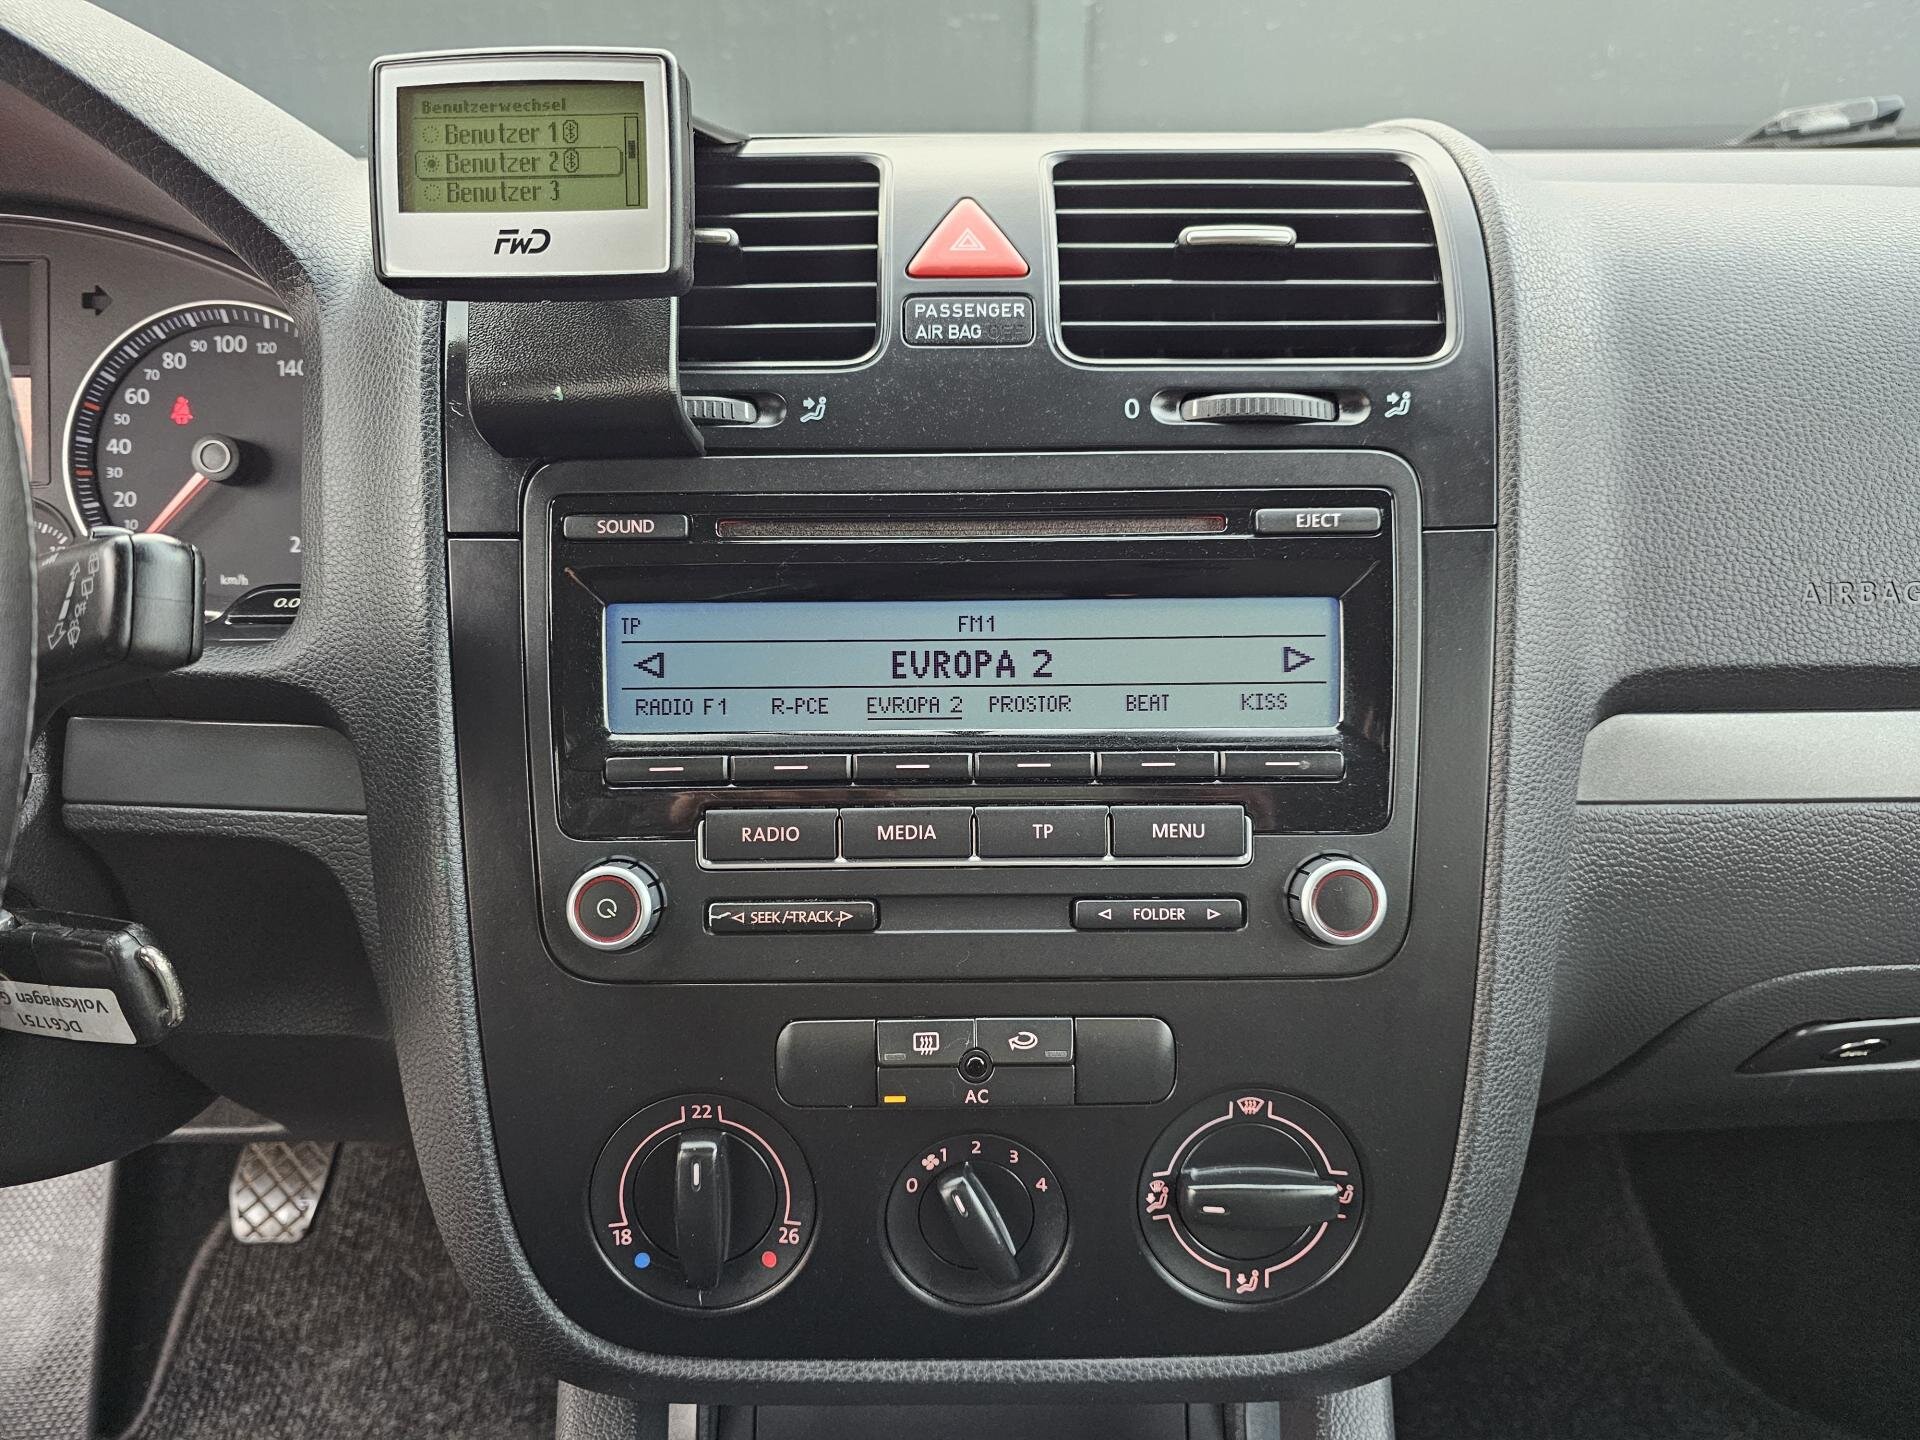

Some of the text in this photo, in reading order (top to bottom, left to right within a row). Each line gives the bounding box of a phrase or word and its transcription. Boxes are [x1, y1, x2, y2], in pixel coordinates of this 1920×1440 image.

[421, 99, 566, 114] Benutzerwechsel
[445, 122, 557, 145] Benutzer 1
[446, 151, 559, 174] Benutzer 2
[447, 180, 560, 203] Benutzer 3
[915, 303, 1025, 318] PASSENGER
[915, 324, 943, 340] AIR
[948, 324, 982, 340] BAG
[190, 339, 208, 353] 90
[213, 334, 248, 354] 100
[255, 341, 278, 355] 120
[162, 352, 187, 370] 80
[144, 368, 160, 382] 70
[124, 387, 150, 405] 60
[1124, 399, 1140, 420] 0
[113, 413, 131, 426] 50
[106, 438, 132, 455] 40
[105, 466, 123, 479] 30
[112, 491, 137, 508] 20
[123, 519, 139, 531] 10
[597, 519, 655, 535] SOUND
[1295, 512, 1342, 529] EJECT
[219, 573, 249, 586] km/h
[1803, 581, 1920, 605] AIRBAG
[621, 617, 641, 635] TP
[958, 615, 996, 633] FM1
[892, 649, 1053, 680] EVROPA 2
[635, 698, 727, 716] RADIO F1
[771, 698, 829, 715] R-PCE
[866, 696, 963, 714] EVROPA 2
[989, 695, 1072, 712] PROSTOR
[1126, 694, 1170, 711] BEAT
[1241, 693, 1288, 710] KISS
[741, 826, 800, 843] RADIO
[877, 825, 937, 841] MEDIA
[1032, 823, 1054, 839] TP
[1152, 823, 1206, 839] MENU
[1133, 908, 1186, 921] FOLDER
[15, 990, 109, 1013] Volkswagen
[17, 1012, 83, 1033] DC61751
[964, 1089, 989, 1104] AC
[691, 1105, 712, 1119] 22
[940, 1148, 948, 1162] 1
[971, 1141, 981, 1154] 2
[1009, 1150, 1019, 1163] 3
[906, 1178, 918, 1192] 0
[1035, 1178, 1048, 1192] 4
[612, 1229, 632, 1246] 18
[778, 1228, 800, 1244] 26
